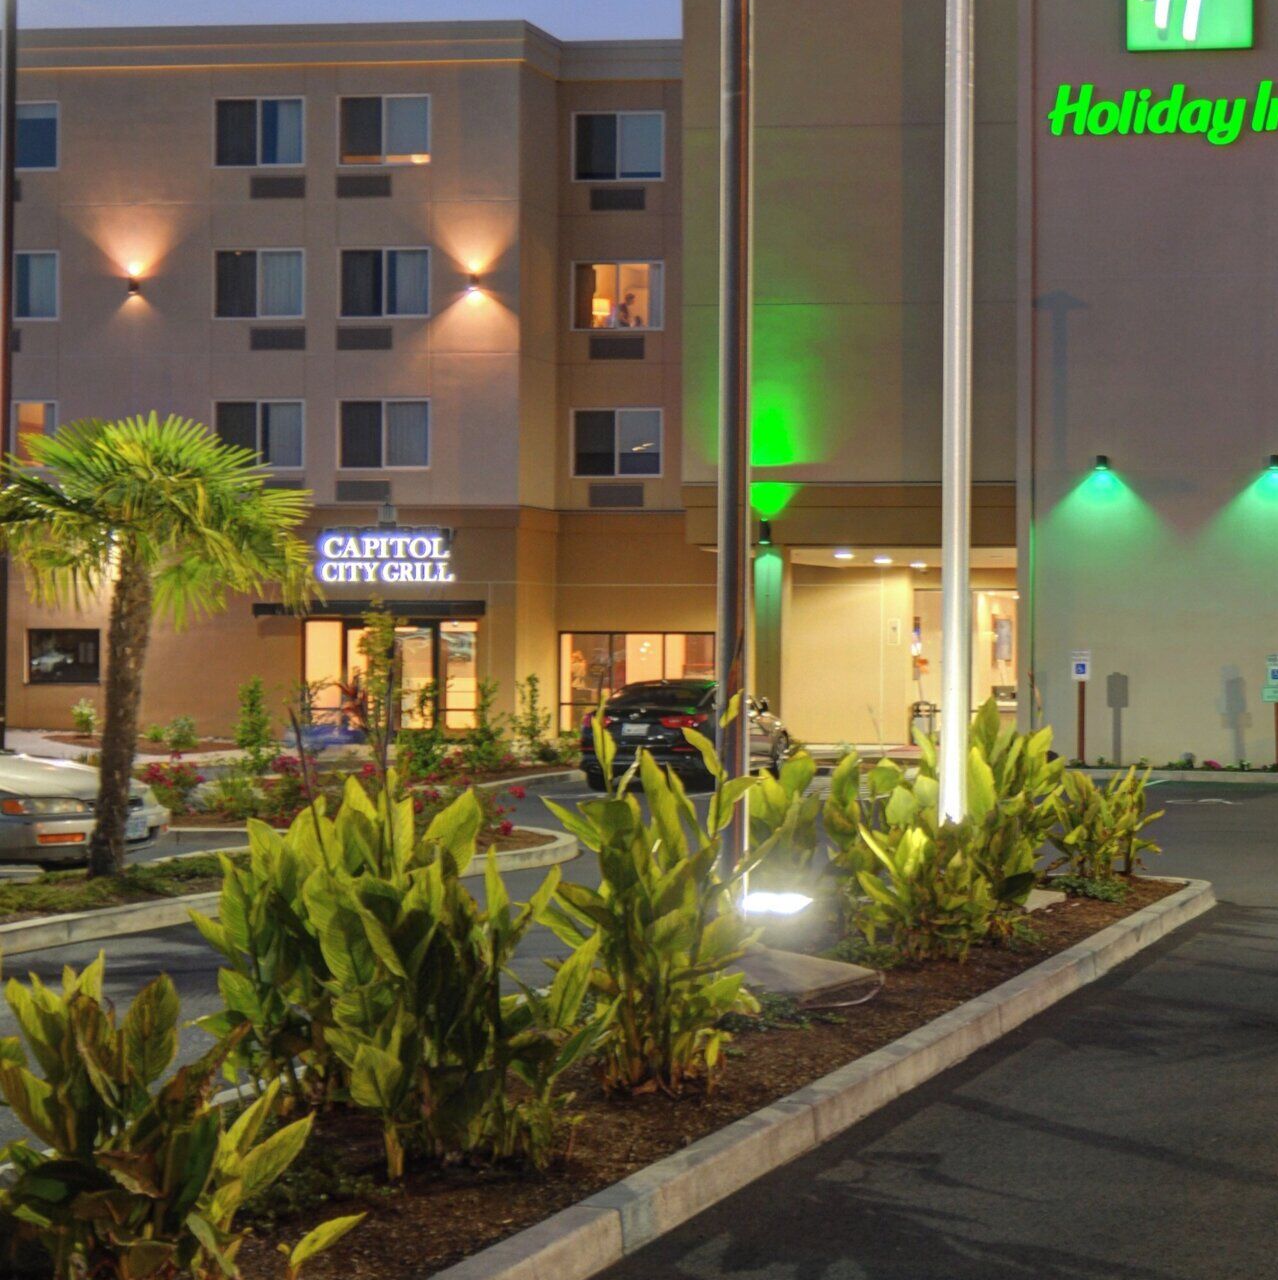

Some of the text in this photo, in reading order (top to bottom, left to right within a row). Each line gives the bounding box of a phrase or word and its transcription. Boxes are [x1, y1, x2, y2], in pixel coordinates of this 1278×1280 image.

[1047, 83, 1247, 146] Holiday
[322, 536, 451, 559] CAPITOL
[321, 561, 456, 583] CITY GRILL
